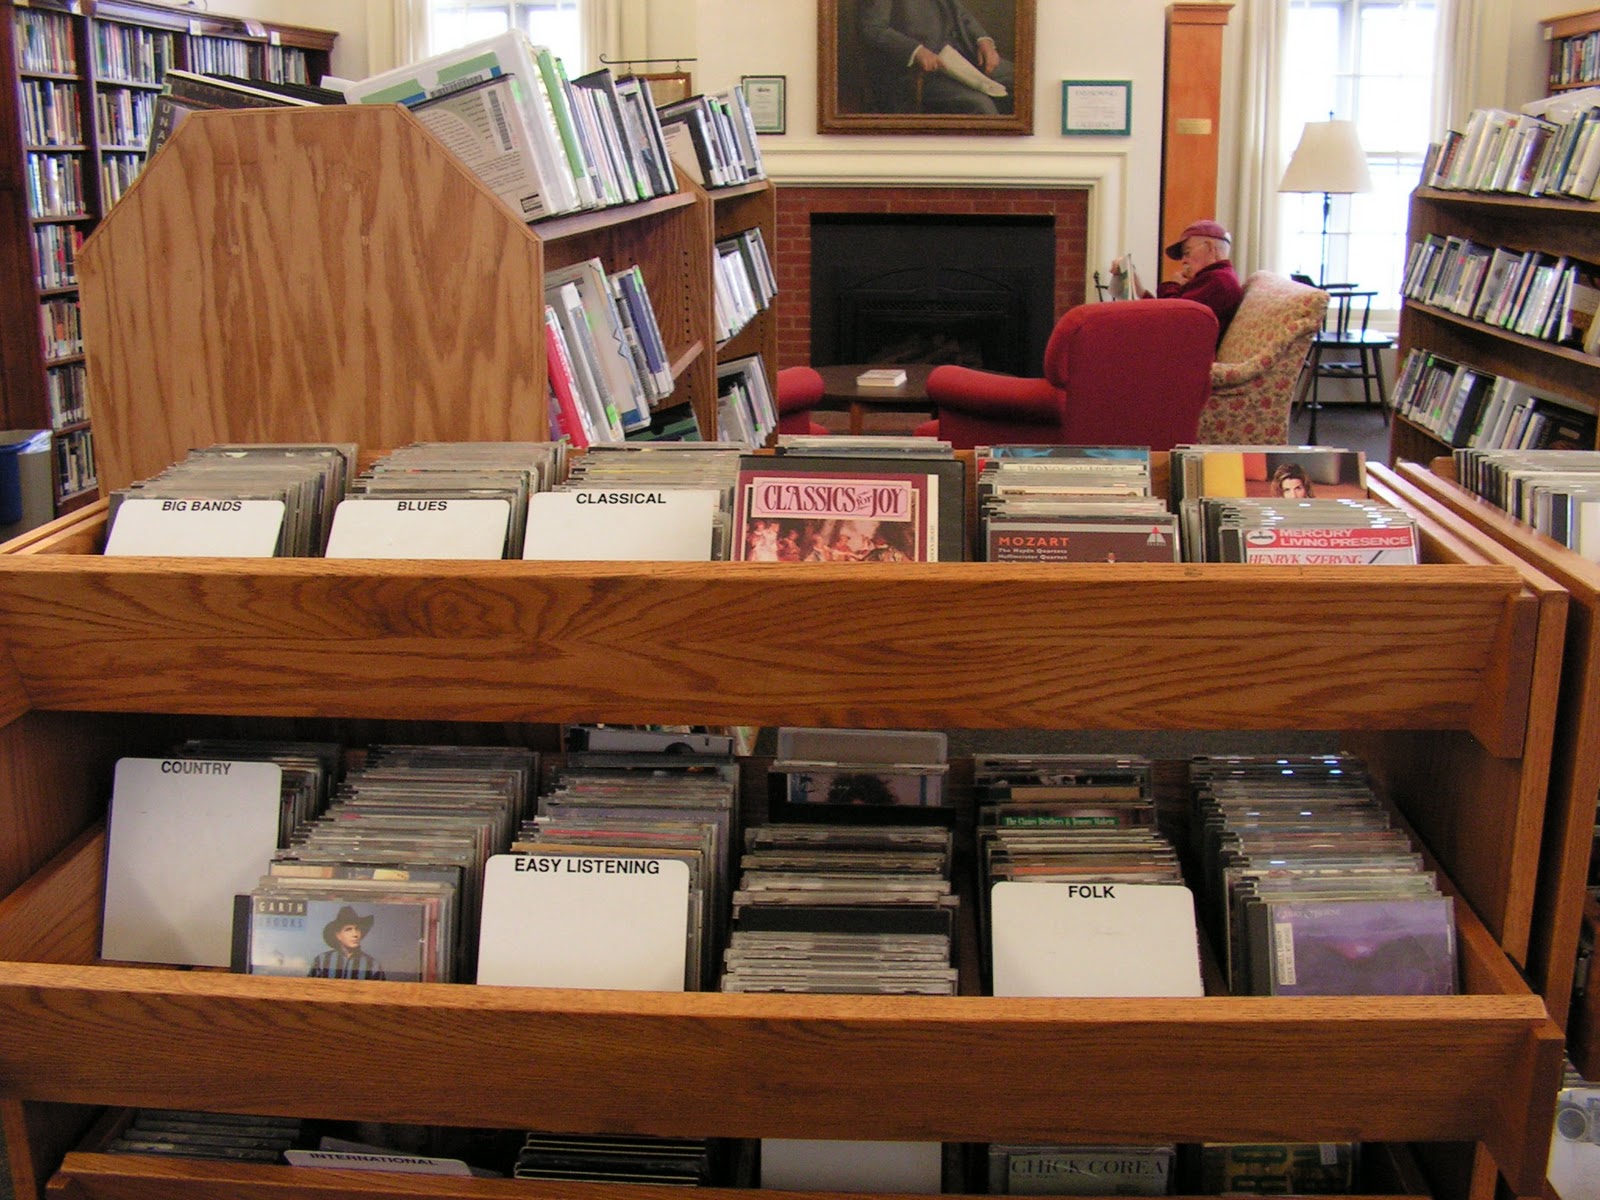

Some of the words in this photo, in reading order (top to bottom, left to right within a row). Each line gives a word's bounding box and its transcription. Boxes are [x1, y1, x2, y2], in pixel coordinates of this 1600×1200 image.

[576, 493, 666, 504] CLASSICAL
[763, 484, 856, 513] CLASSICS
[856, 494, 873, 508] for
[870, 487, 902, 517] JOY
[162, 501, 187, 511] BIG
[191, 501, 242, 511] BANDS
[397, 501, 448, 511] BLUES
[1279, 528, 1353, 538] MERCURY
[998, 536, 1070, 546] MOZART
[1280, 537, 1329, 547] LIVING
[1330, 536, 1410, 547] PRESENCE
[161, 761, 232, 775] COUNTRY
[514, 858, 562, 872] EASY
[566, 859, 660, 874] LISTENING
[1068, 886, 1115, 898] FOLK
[258, 901, 304, 913] GARTH
[309, 1153, 439, 1166] INTERNATIONAL
[1011, 1159, 1081, 1174] CHICK
[1088, 1159, 1164, 1174] COREA
